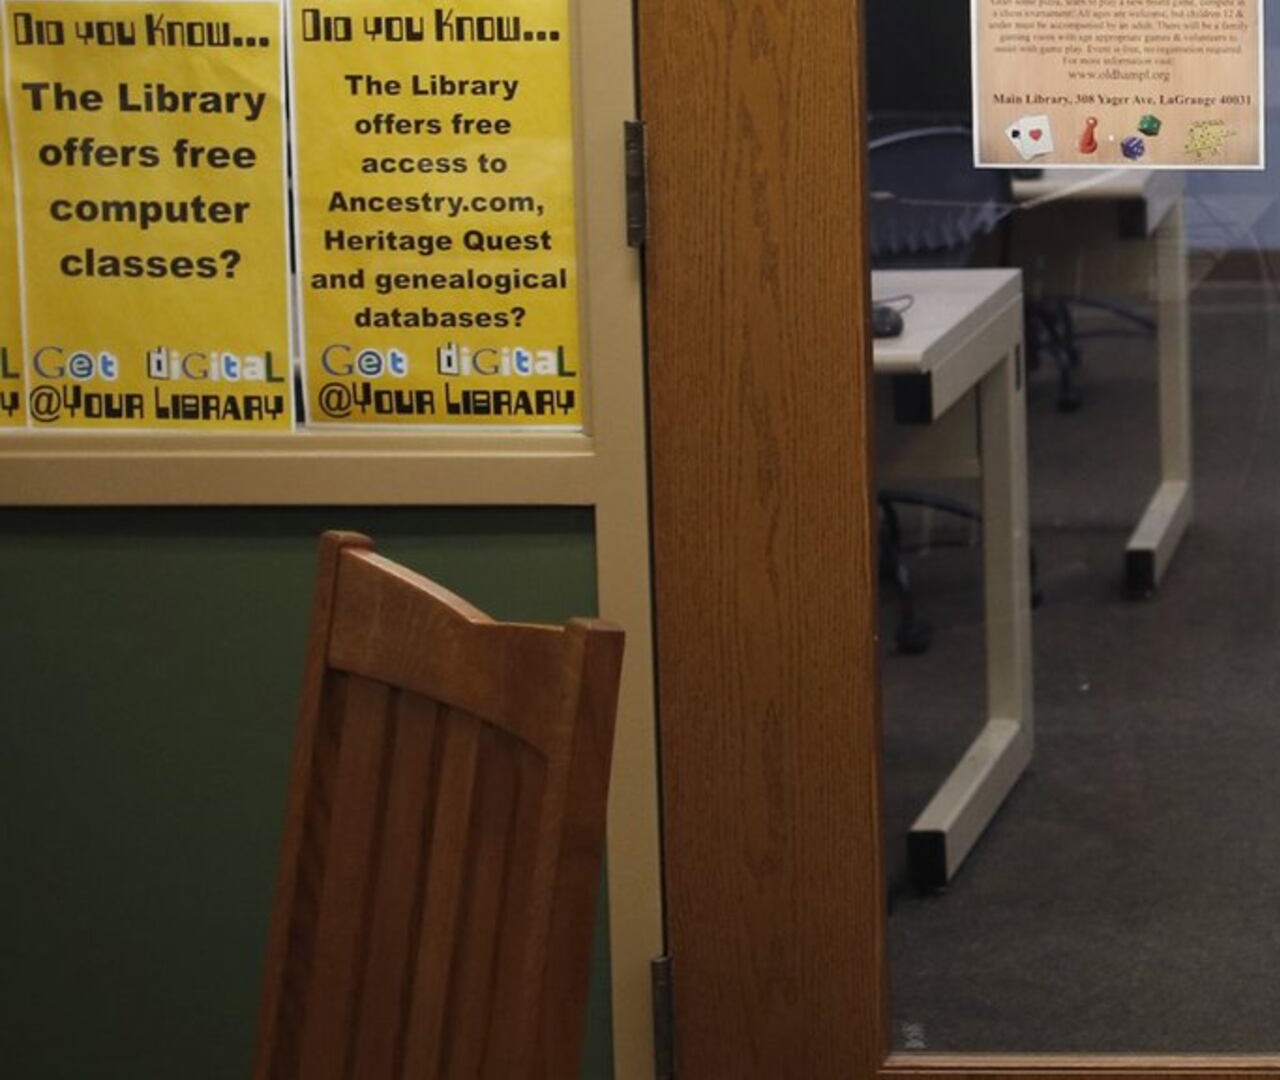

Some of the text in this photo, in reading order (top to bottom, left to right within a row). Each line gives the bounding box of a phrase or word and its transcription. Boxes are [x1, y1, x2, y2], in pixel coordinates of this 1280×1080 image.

[22, 82, 267, 121] The Library
[345, 75, 519, 102] The Library
[993, 93, 1023, 106] Main
[354, 113, 512, 135] offers free
[38, 138, 257, 170] offers free
[361, 152, 508, 174] access to
[49, 195, 250, 229] computer
[328, 191, 545, 219] Ancestry.com,
[324, 229, 552, 255] Heritage Quest
[60, 249, 242, 280] classes?
[311, 269, 568, 296] and genealogical
[354, 307, 526, 329] databases?
